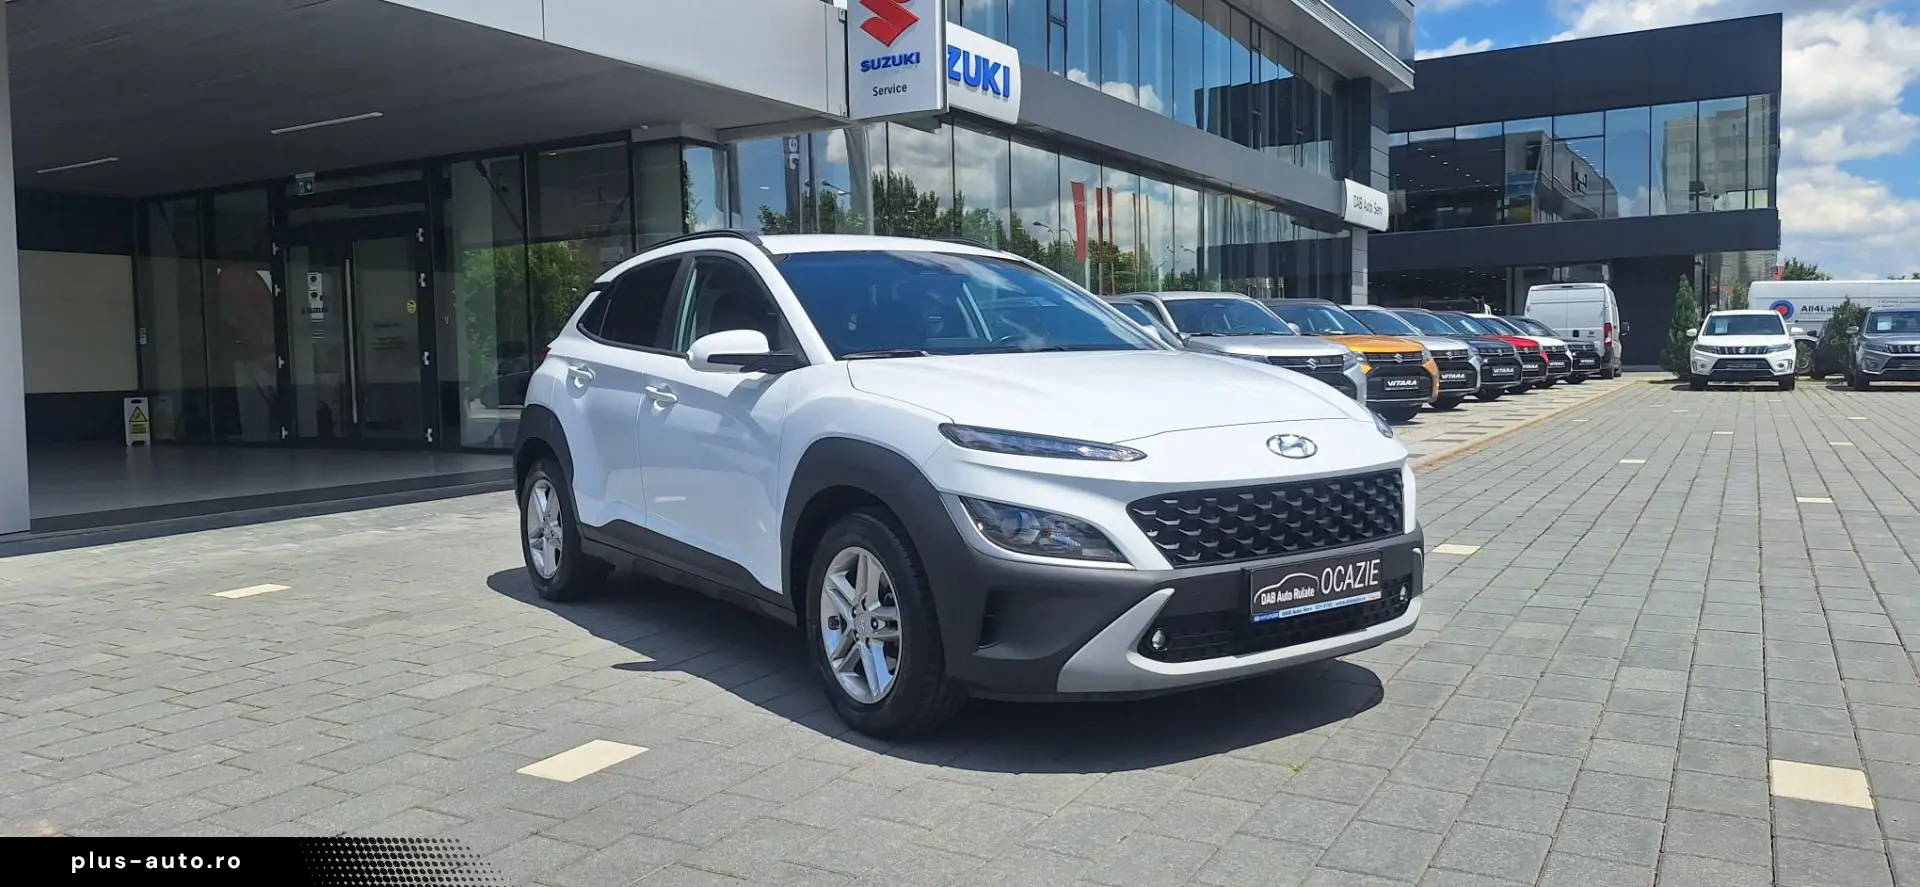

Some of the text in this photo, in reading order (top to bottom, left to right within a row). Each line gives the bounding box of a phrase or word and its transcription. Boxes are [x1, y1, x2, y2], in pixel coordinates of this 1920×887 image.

[860, 52, 921, 72] SUZUKI
[947, 44, 1010, 98] ZUKI
[873, 83, 908, 97] Service
[1800, 304, 1839, 312] All4Lab
[1387, 379, 1418, 387] VITARA
[1321, 559, 1381, 595] OCAZIE
[1261, 586, 1316, 606] DAB Auto Rulate
